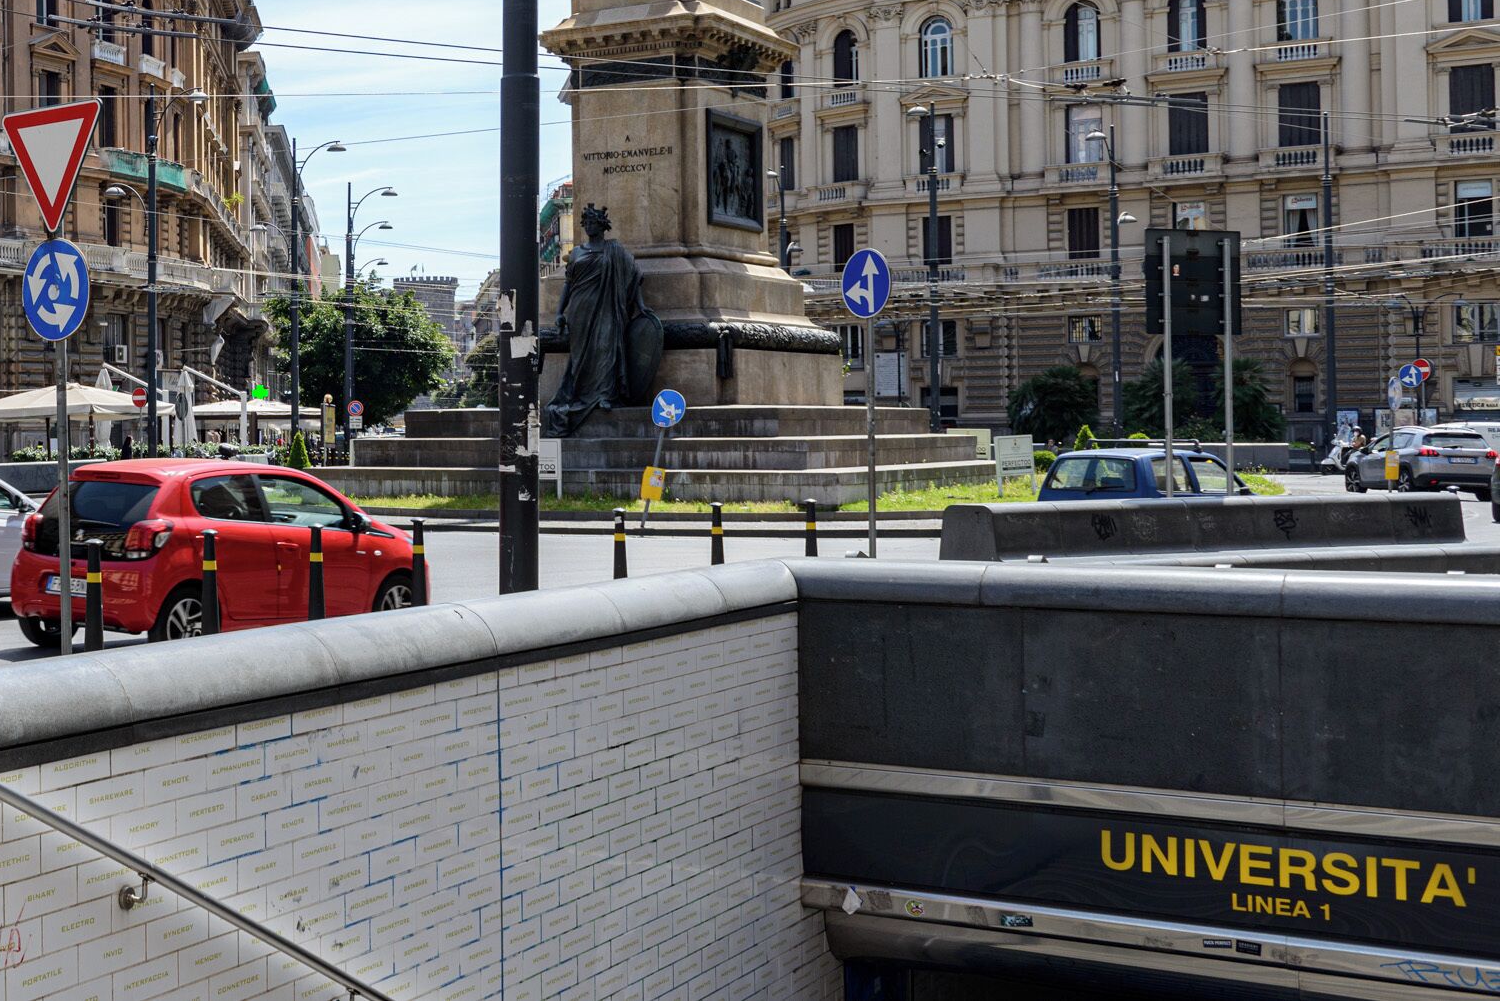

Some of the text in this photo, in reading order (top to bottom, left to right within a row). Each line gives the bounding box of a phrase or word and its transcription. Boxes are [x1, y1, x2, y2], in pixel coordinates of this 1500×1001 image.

[242, 717, 286, 732] HOLOGRAPHIC
[180, 728, 233, 745] METAMORPHISM
[134, 747, 152, 756] LINK
[54, 758, 97, 773] ALGORITHM
[211, 758, 261, 776] ALPHANUMERIC
[162, 774, 190, 787] REMOTE
[88, 788, 134, 805] SHAREWARE
[189, 803, 225, 818] IPERTESTO
[129, 820, 160, 834] MEMORY
[220, 831, 255, 847] OPERATIVO
[154, 847, 199, 866] CONNETTORE
[1101, 828, 1476, 908] UNIVERSITA'
[27, 887, 57, 903] BINARY
[1232, 892, 1332, 921] LINEA 1
[61, 917, 96, 933] ELECTRO
[163, 923, 195, 940] SYNERGY
[103, 948, 124, 960] INVIO
[194, 952, 223, 966] MEMORY
[22, 967, 63, 988] PORTATILE
[123, 970, 169, 992] INTERFACCIA
[217, 973, 261, 996] CONNETTORE
